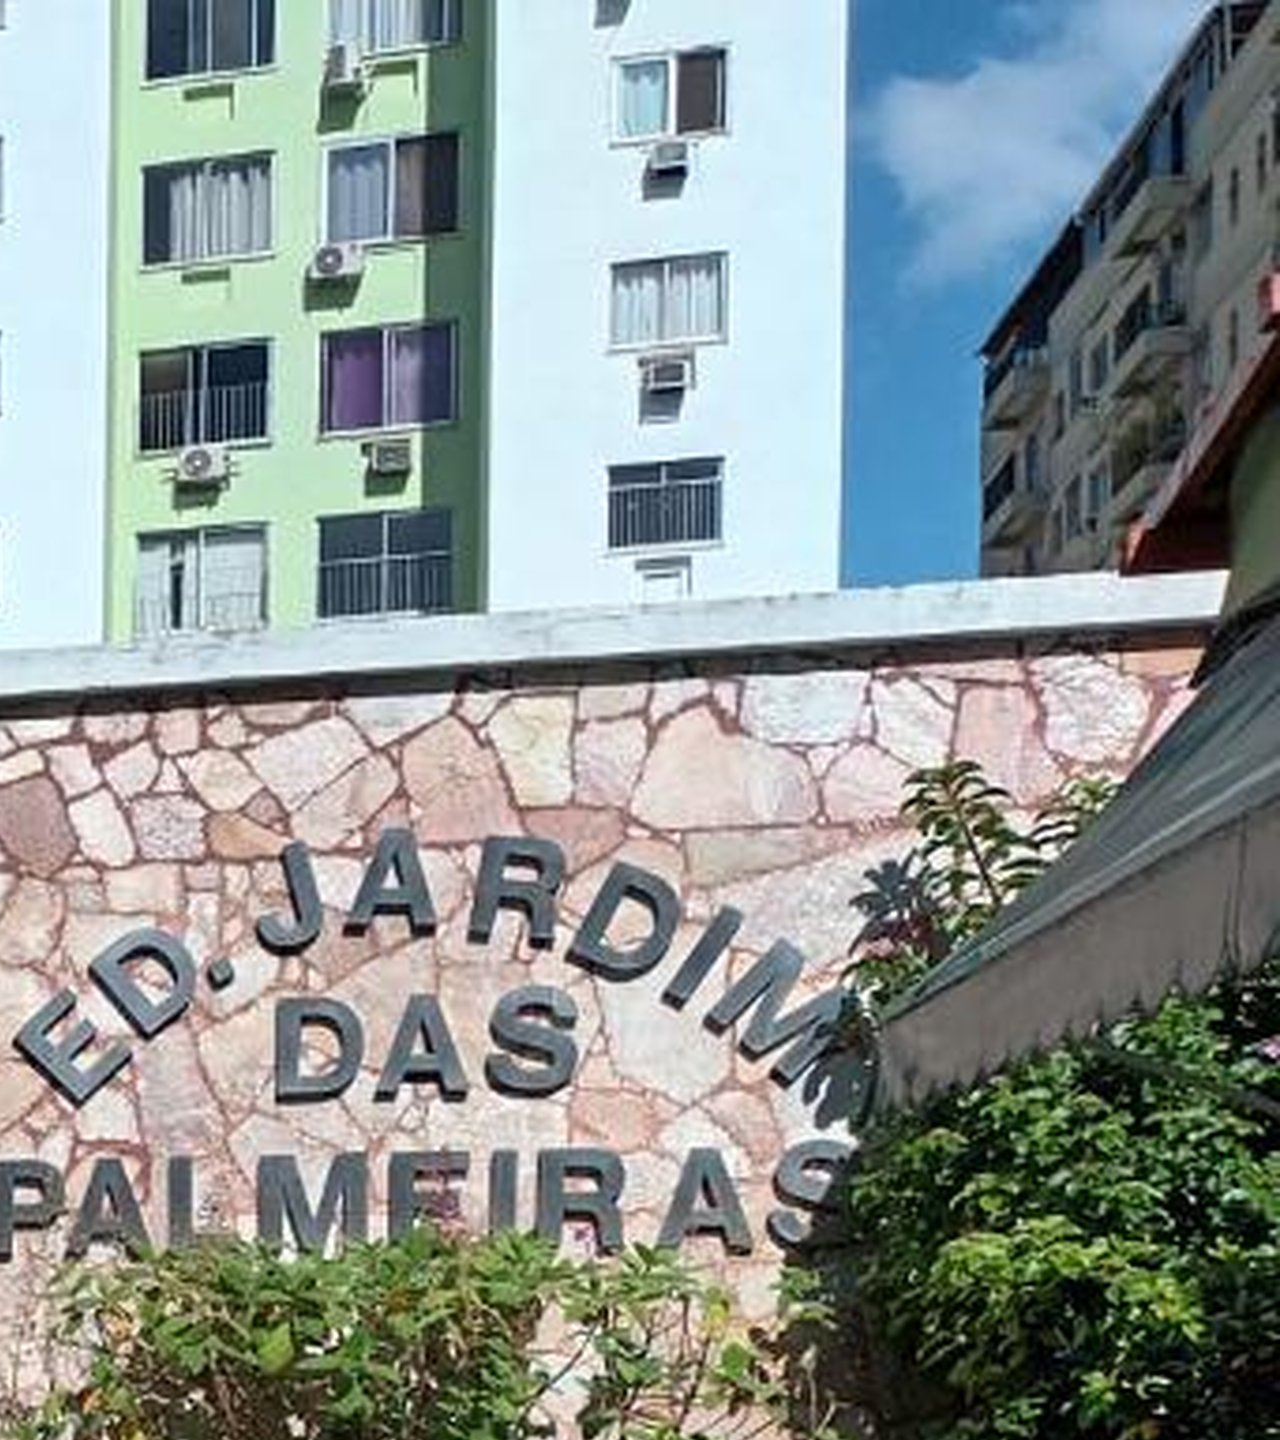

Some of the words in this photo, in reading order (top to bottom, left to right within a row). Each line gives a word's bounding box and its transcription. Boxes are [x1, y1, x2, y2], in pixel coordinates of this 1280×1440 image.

[12, 926, 235, 1108] ED.
[254, 828, 862, 1090] JARDIM
[274, 985, 579, 1104] DAS
